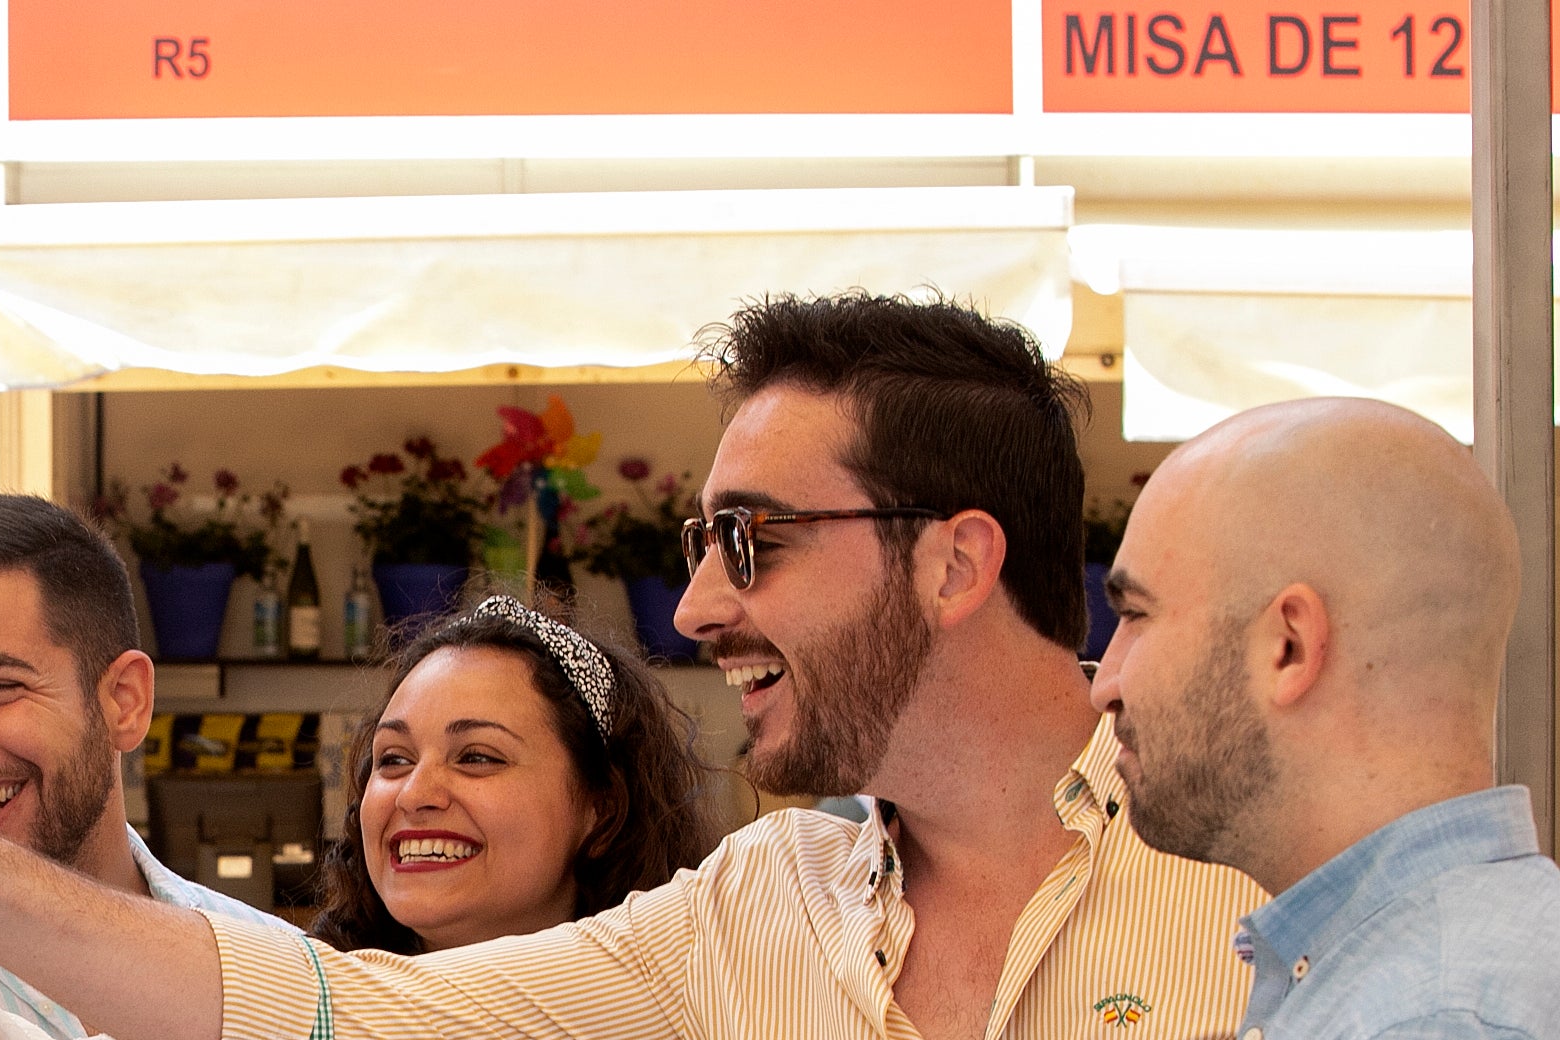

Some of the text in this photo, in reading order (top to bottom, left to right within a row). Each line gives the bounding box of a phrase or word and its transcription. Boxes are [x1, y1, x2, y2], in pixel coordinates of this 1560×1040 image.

[154, 38, 209, 77] R5
[1065, 15, 1463, 76] MISA DE 12
